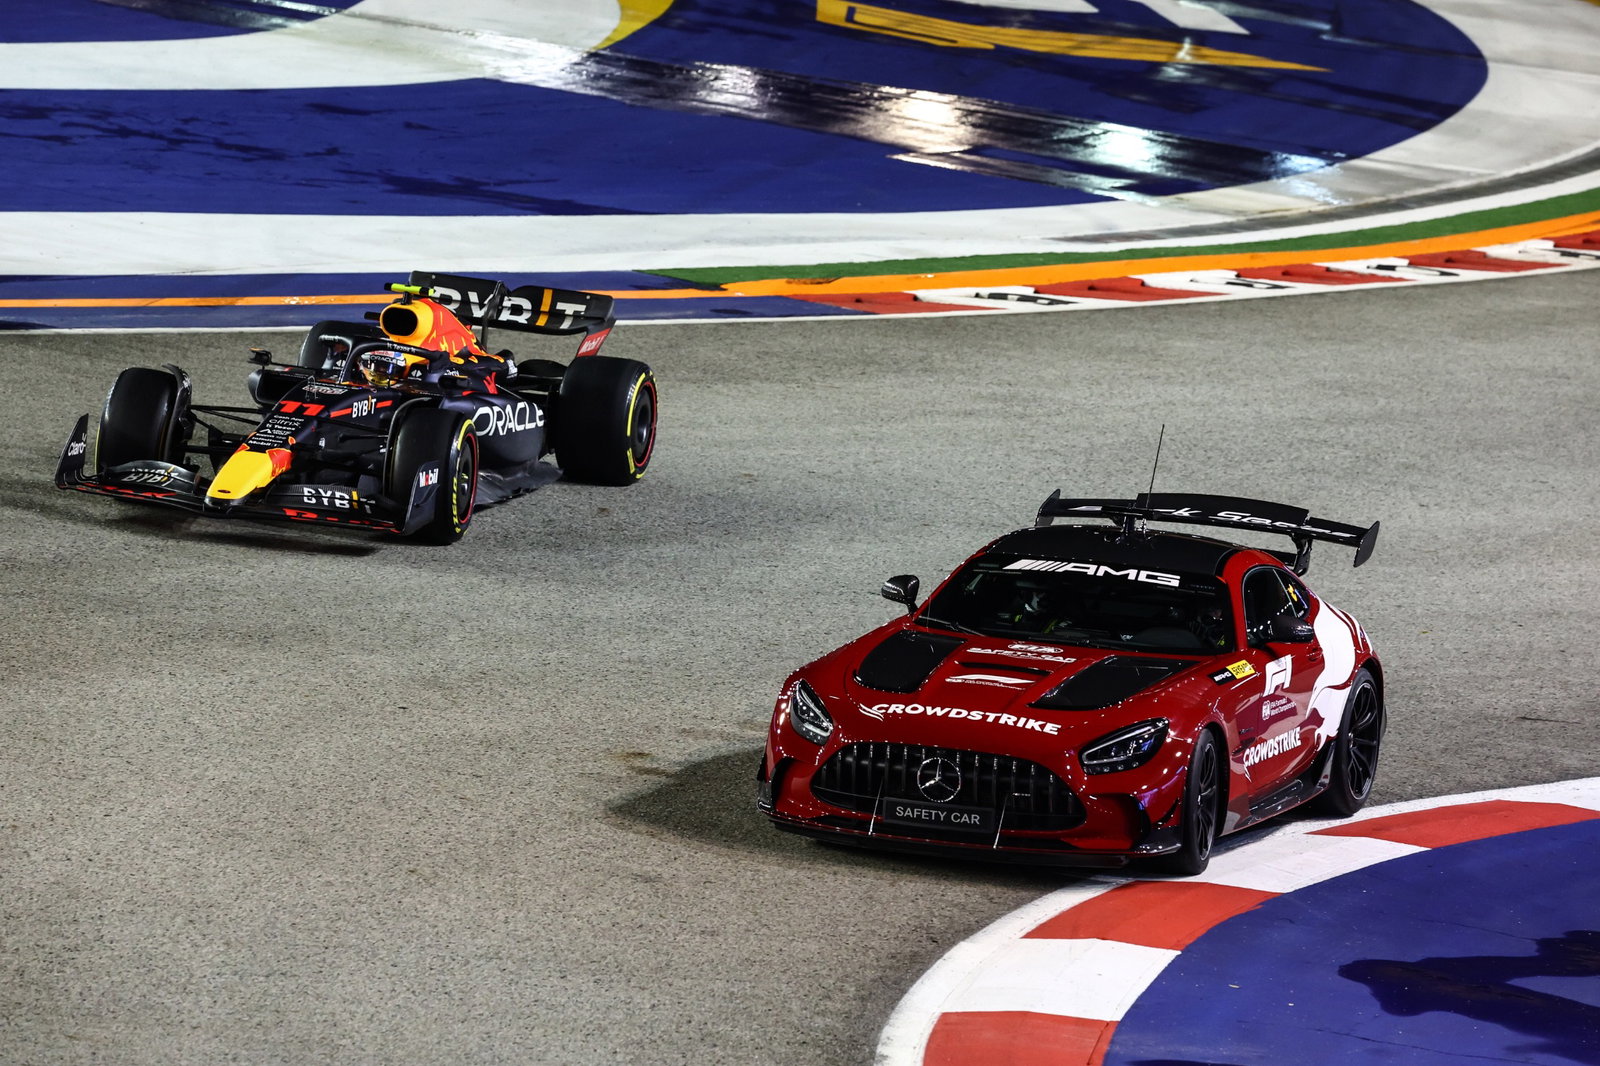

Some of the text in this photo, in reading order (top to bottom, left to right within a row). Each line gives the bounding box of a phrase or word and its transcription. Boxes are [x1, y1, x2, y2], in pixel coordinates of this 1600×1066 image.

[280, 400, 326, 417] 11
[352, 395, 377, 418] BYBIT
[471, 401, 545, 436] ORACLE
[67, 441, 86, 457] Claro
[419, 467, 439, 488] Mobil
[303, 487, 376, 514] BYBIT
[1055, 562, 1181, 587] AMG
[966, 647, 1038, 657] SAFETY
[870, 703, 1062, 735] CROWDSTRIKE
[1243, 727, 1301, 767] CROWDSTRIKE
[896, 806, 980, 825] SAFETY CAR
